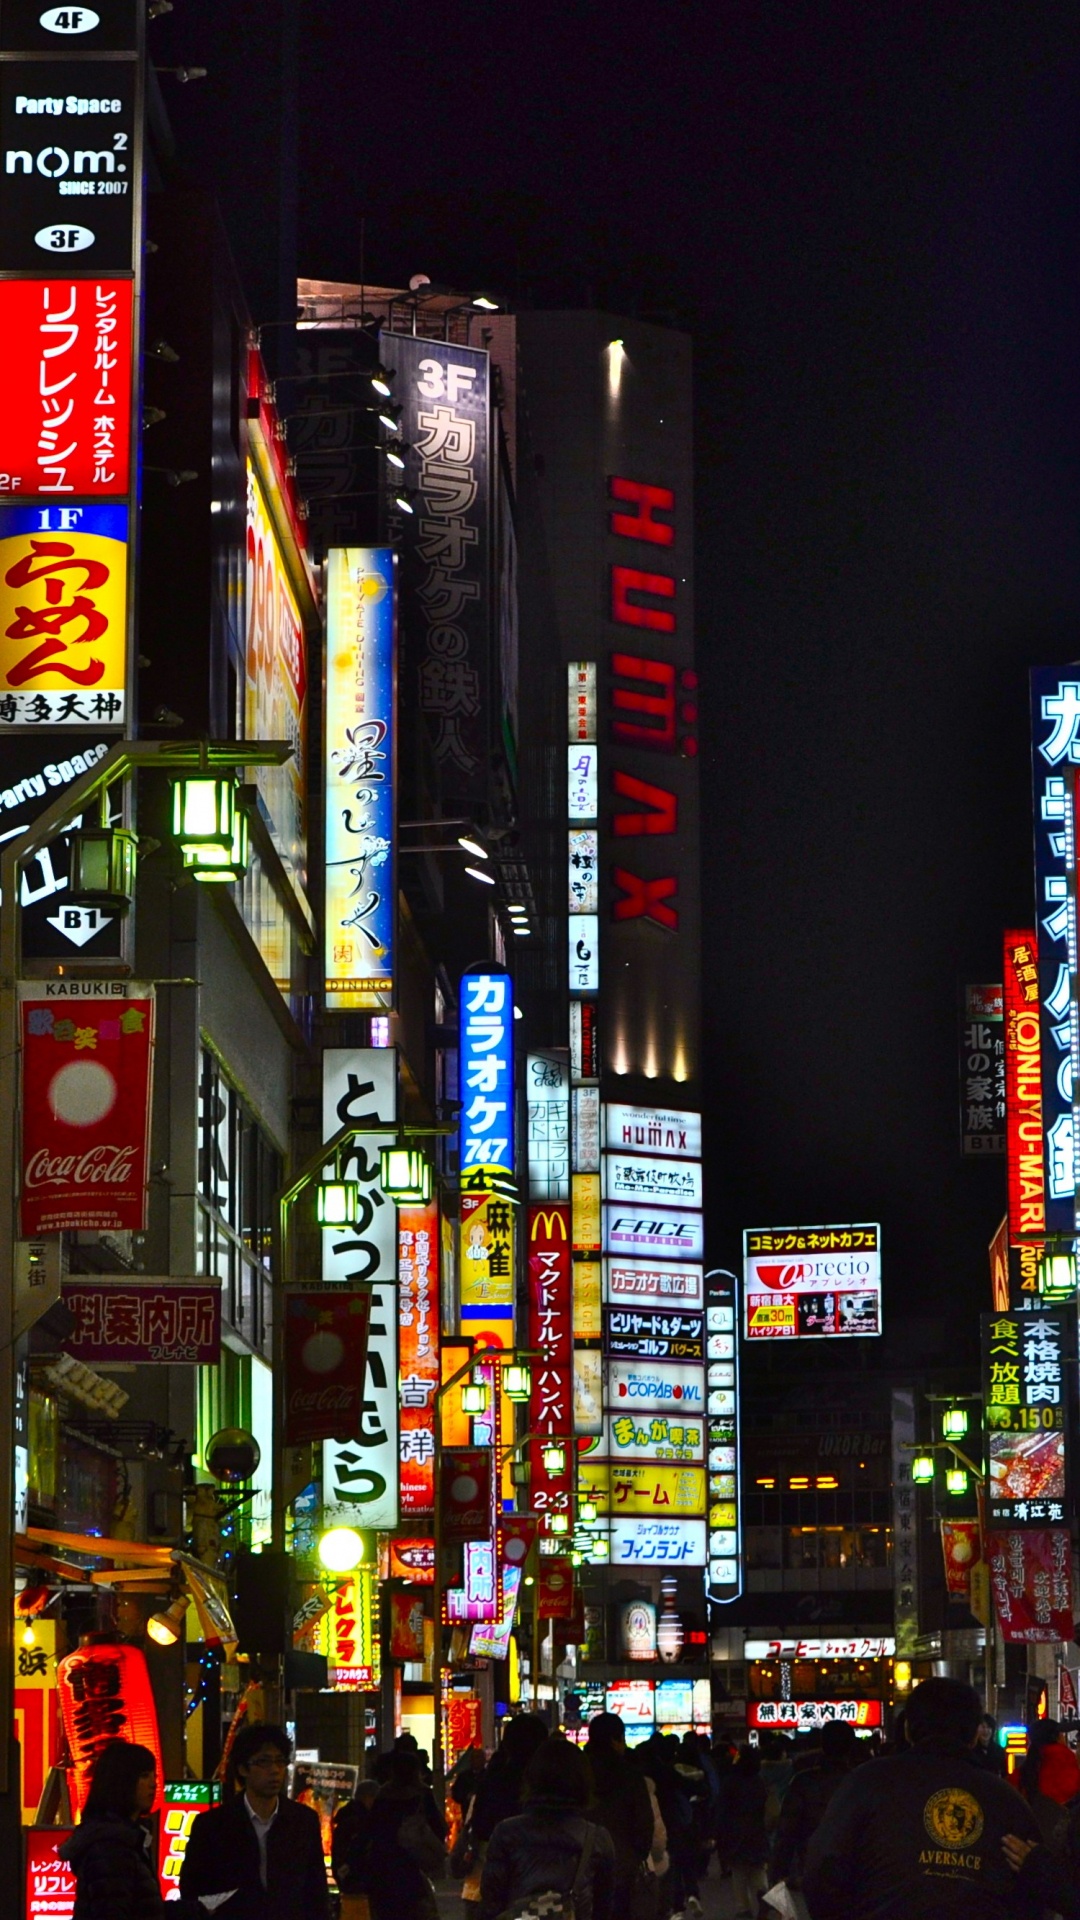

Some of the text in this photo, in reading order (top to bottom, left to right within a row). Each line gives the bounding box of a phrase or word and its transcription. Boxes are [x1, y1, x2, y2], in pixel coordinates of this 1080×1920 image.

[55, 11, 83, 29] 4F
[16, 96, 122, 115] Party Space
[59, 181, 128, 195] SINCE 2007
[50, 229, 80, 248] 3F
[37, 286, 79, 491] リフレッシュ
[93, 286, 118, 482] レンタルルーム ホステル
[417, 358, 476, 399] 3F
[0, 474, 21, 490] 2F
[38, 508, 83, 530] 1F
[356, 568, 365, 628] PRIVATE
[416, 404, 479, 776] カラオケの鉄人
[5, 540, 110, 686] らーめん
[355, 634, 365, 686] DINING
[0, 692, 122, 723] 博多天神
[611, 475, 698, 934] HUMAX
[43, 743, 109, 787] Space
[64, 910, 97, 928] B1
[330, 980, 388, 990] DINING
[1012, 944, 1039, 1001] 居酒屋
[466, 975, 507, 1135] カラオケ
[964, 1024, 994, 1130] 北の家族
[531, 1103, 546, 1159] カドー
[622, 1111, 687, 1124] wonderful time
[464, 1138, 508, 1163] 747
[552, 1102, 567, 1199] ギャラリー
[622, 1122, 687, 1149] HUMAX
[25, 1145, 139, 1188] Coca-Cola
[462, 1198, 479, 1209] 3F
[581, 1176, 593, 1240] PASSAGE
[487, 1201, 511, 1277] 麻雀
[612, 1218, 700, 1239] FACE
[779, 1256, 870, 1287] aprecio
[810, 1278, 867, 1288] アプレシオ
[582, 1262, 595, 1328] PASSAGE
[66, 1294, 215, 1346] 料案内所
[989, 1318, 1021, 1405] 食べ放題
[1023, 1318, 1061, 1405] 本格焼肉
[401, 1376, 435, 1464] 吉祥
[613, 1417, 700, 1448] まんが喫茶
[400, 1482, 428, 1491] hinese
[400, 1493, 415, 1504] yle
[614, 1480, 670, 1505] ゲーム
[636, 1524, 680, 1536] ジョイフルサウナ
[621, 1540, 695, 1560] フィンランド
[469, 1541, 494, 1602] 内所
[611, 1702, 652, 1716] ゲーム
[758, 1702, 856, 1721] 無料案内所
[31, 1860, 72, 1873] レンタル
[34, 1876, 77, 1892] リフレ
